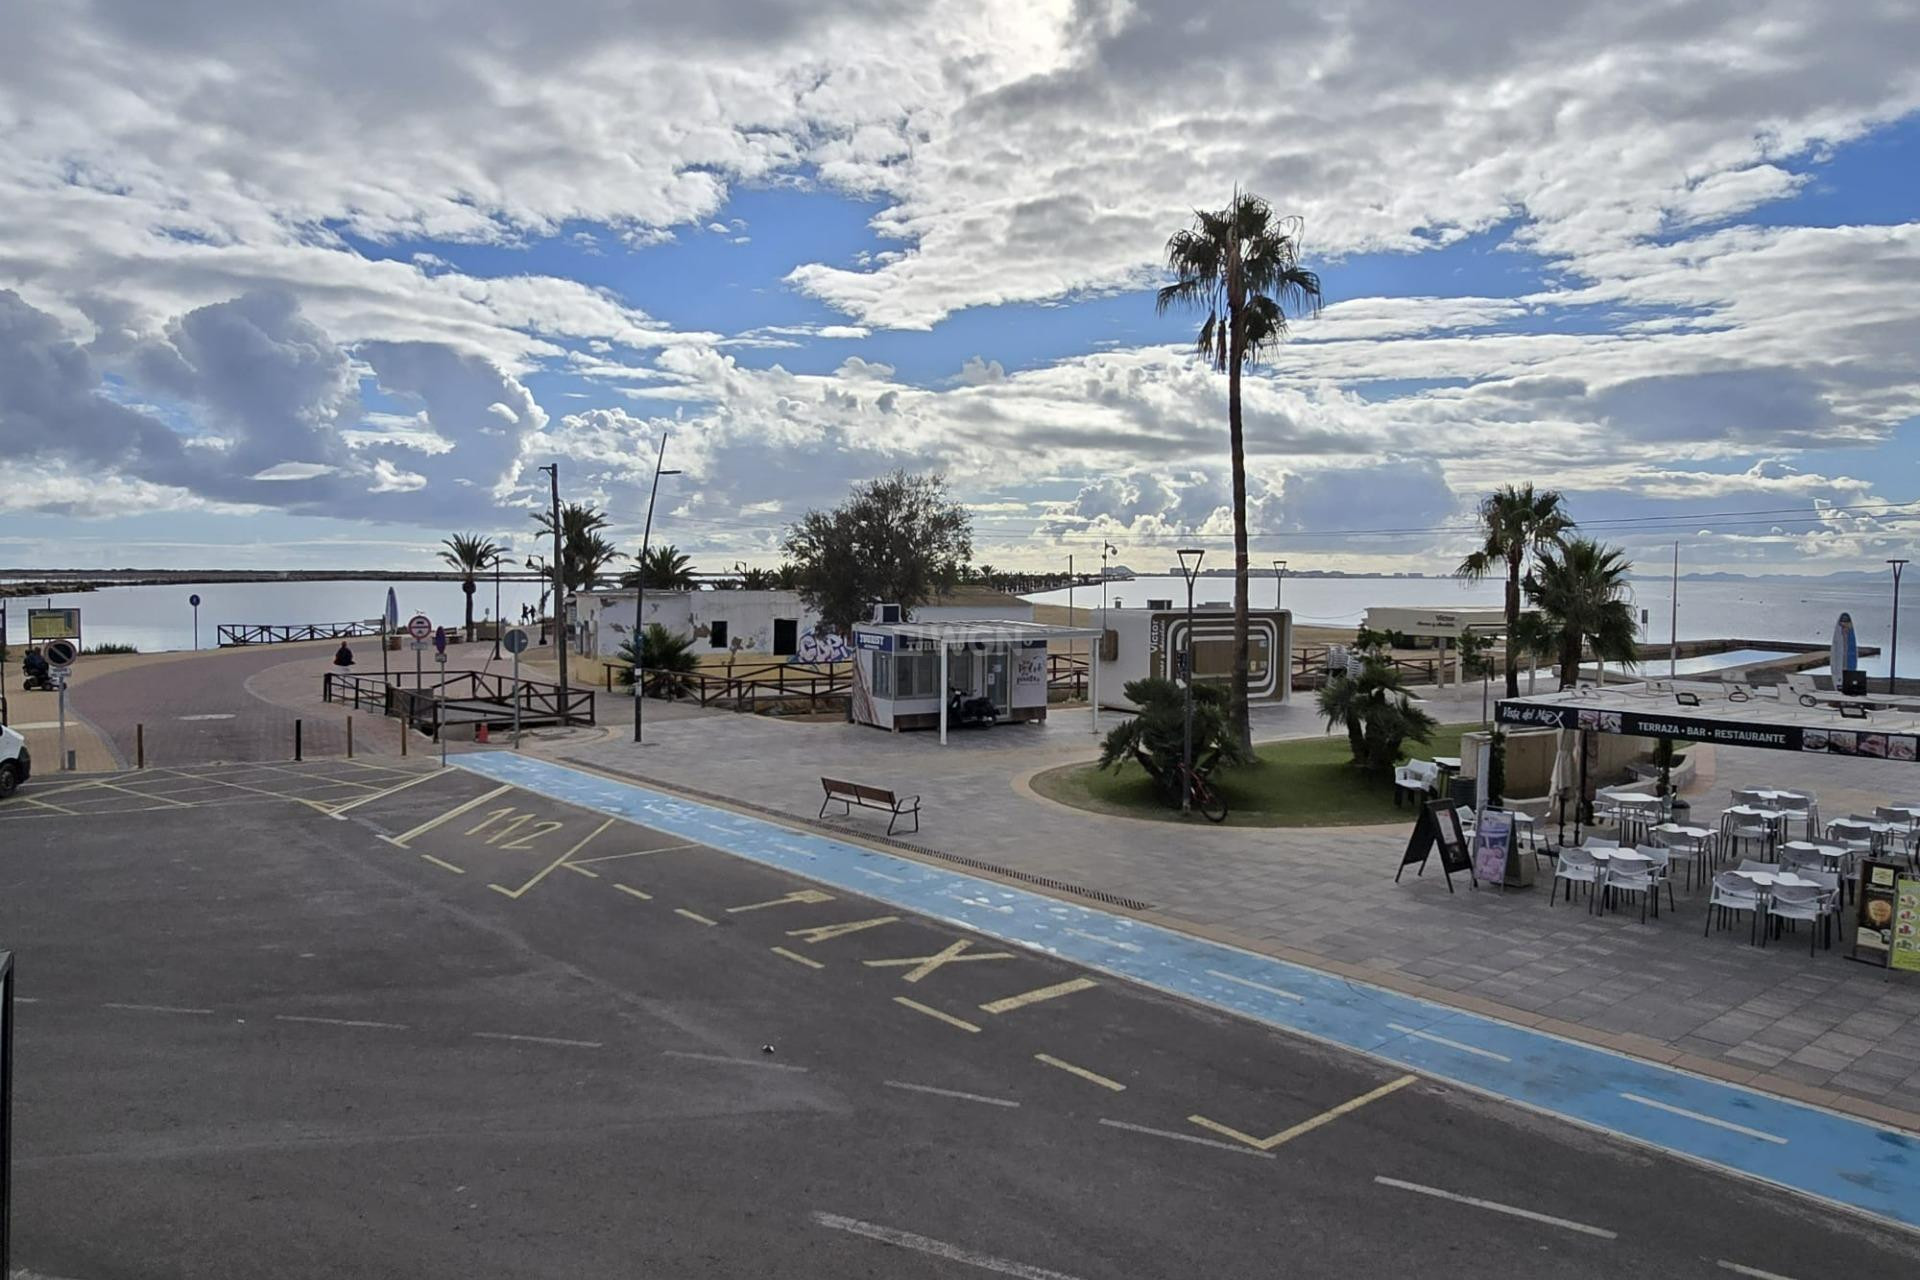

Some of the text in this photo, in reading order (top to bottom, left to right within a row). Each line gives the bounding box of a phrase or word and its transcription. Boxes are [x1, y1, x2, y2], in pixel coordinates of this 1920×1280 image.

[1638, 721, 1786, 744] TERRAZA BAR RESTAURANTE
[464, 807, 562, 849] 112
